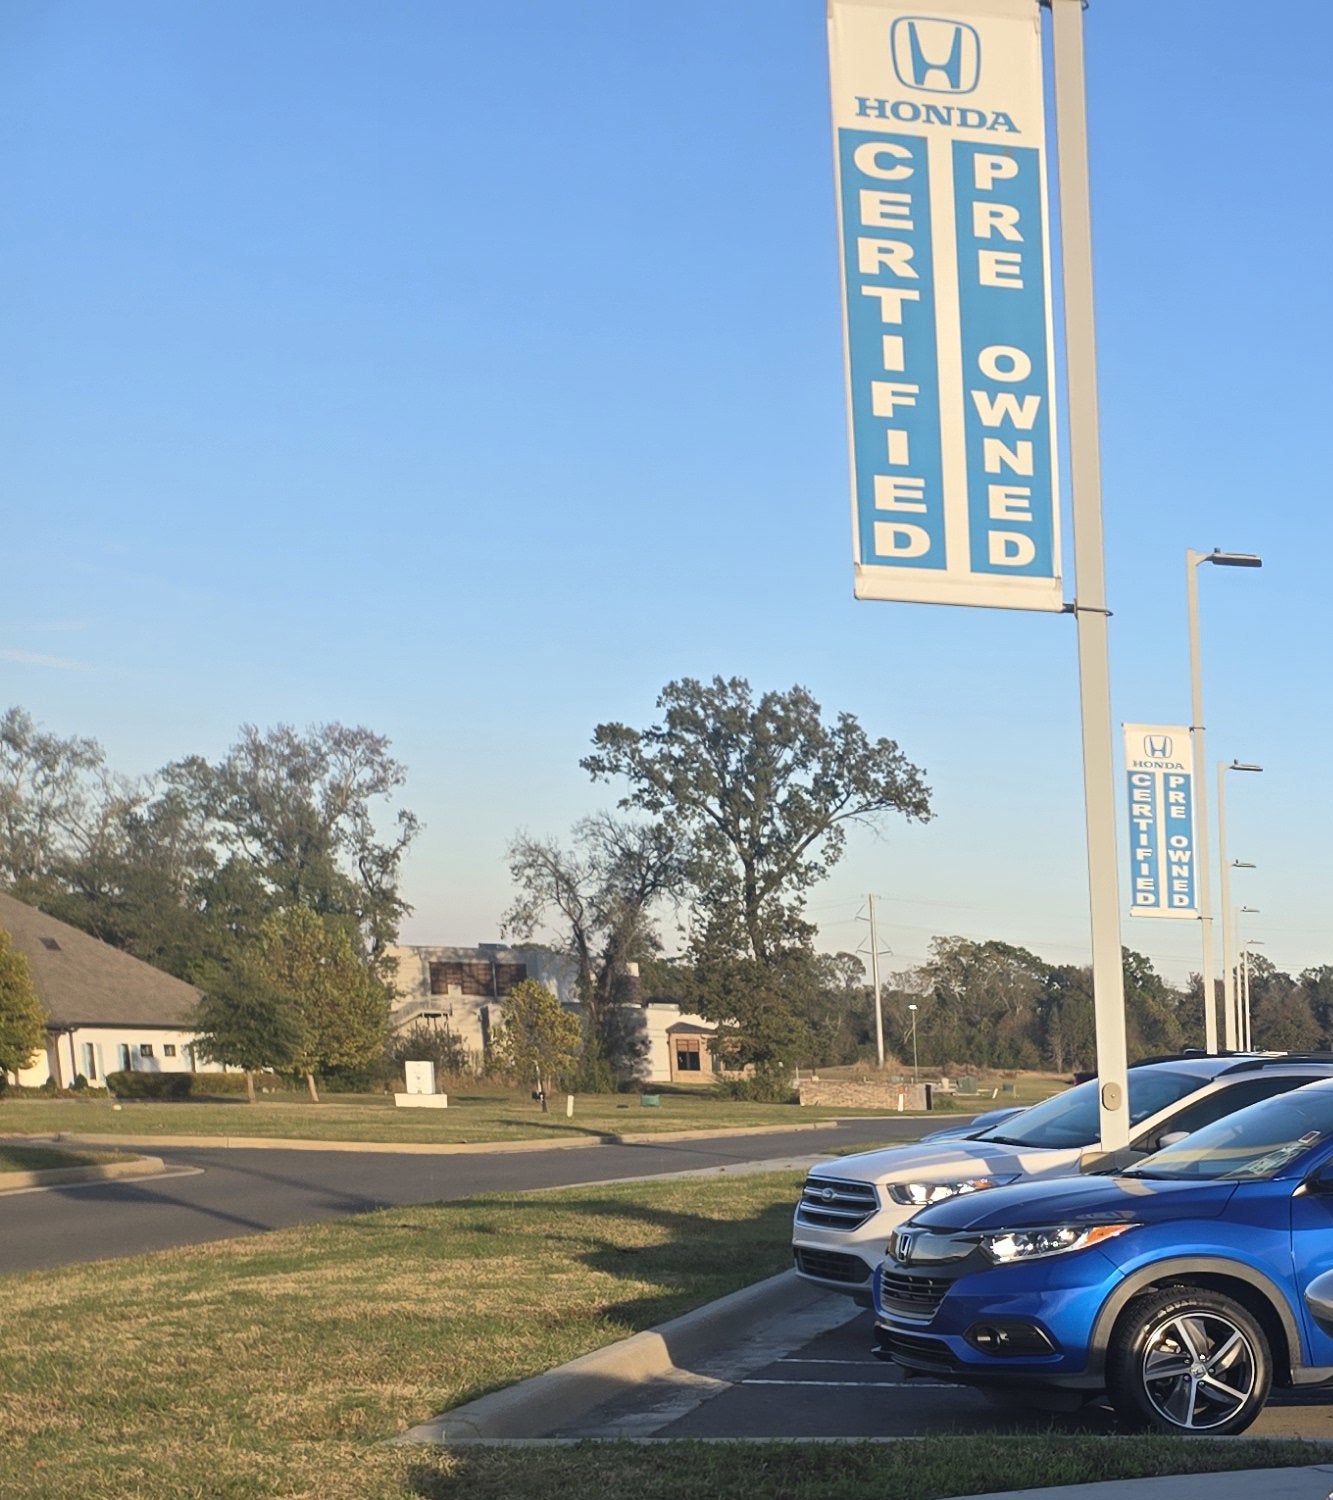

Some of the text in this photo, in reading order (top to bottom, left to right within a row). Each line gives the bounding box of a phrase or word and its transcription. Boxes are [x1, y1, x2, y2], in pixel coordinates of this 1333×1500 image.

[855, 96, 1021, 133] HONDA
[853, 142, 931, 559] CERTIFIED
[970, 153, 1041, 567] PRE OWNED
[1133, 760, 1184, 770] HONDA
[1131, 774, 1156, 905] CERTIFIED
[1168, 776, 1192, 907] PRE OWNED
